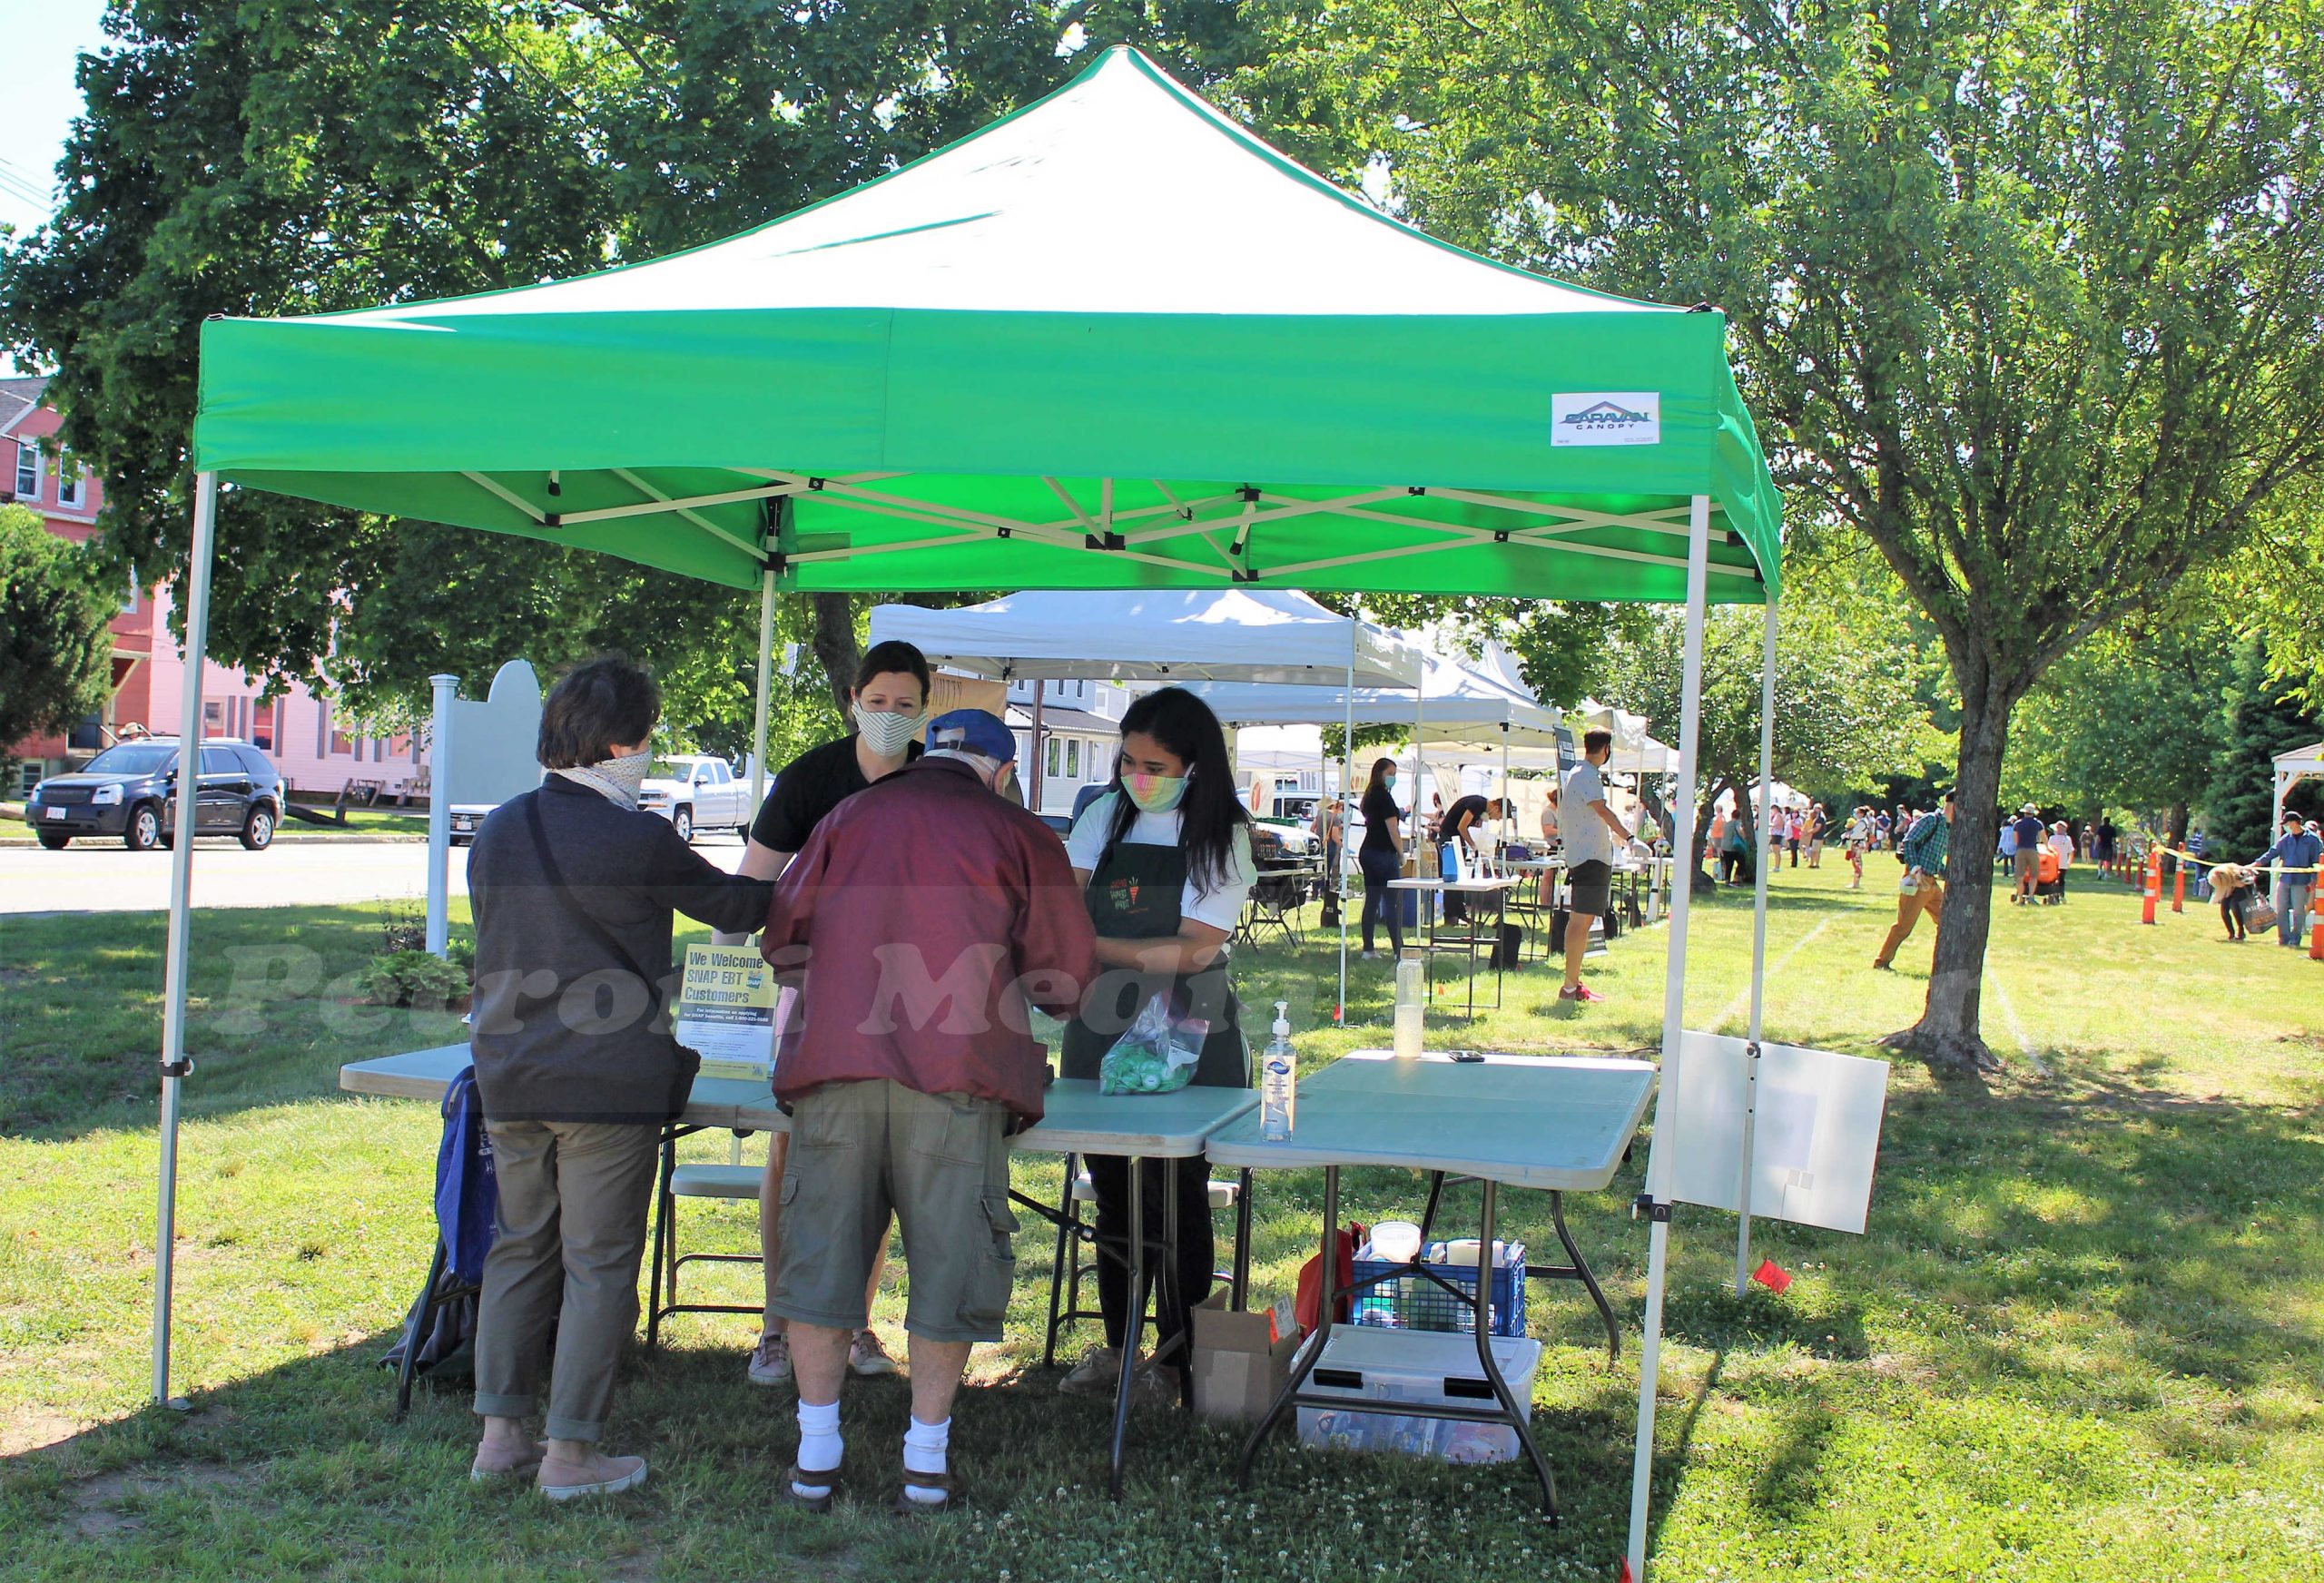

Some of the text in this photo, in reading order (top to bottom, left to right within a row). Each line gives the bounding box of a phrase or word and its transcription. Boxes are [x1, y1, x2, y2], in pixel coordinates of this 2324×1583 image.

[1561, 412, 1651, 424] CARAVAN
[689, 951, 763, 969] We Welcome
[686, 968, 743, 986] SNAP EBT
[684, 986, 750, 1004] Customers
